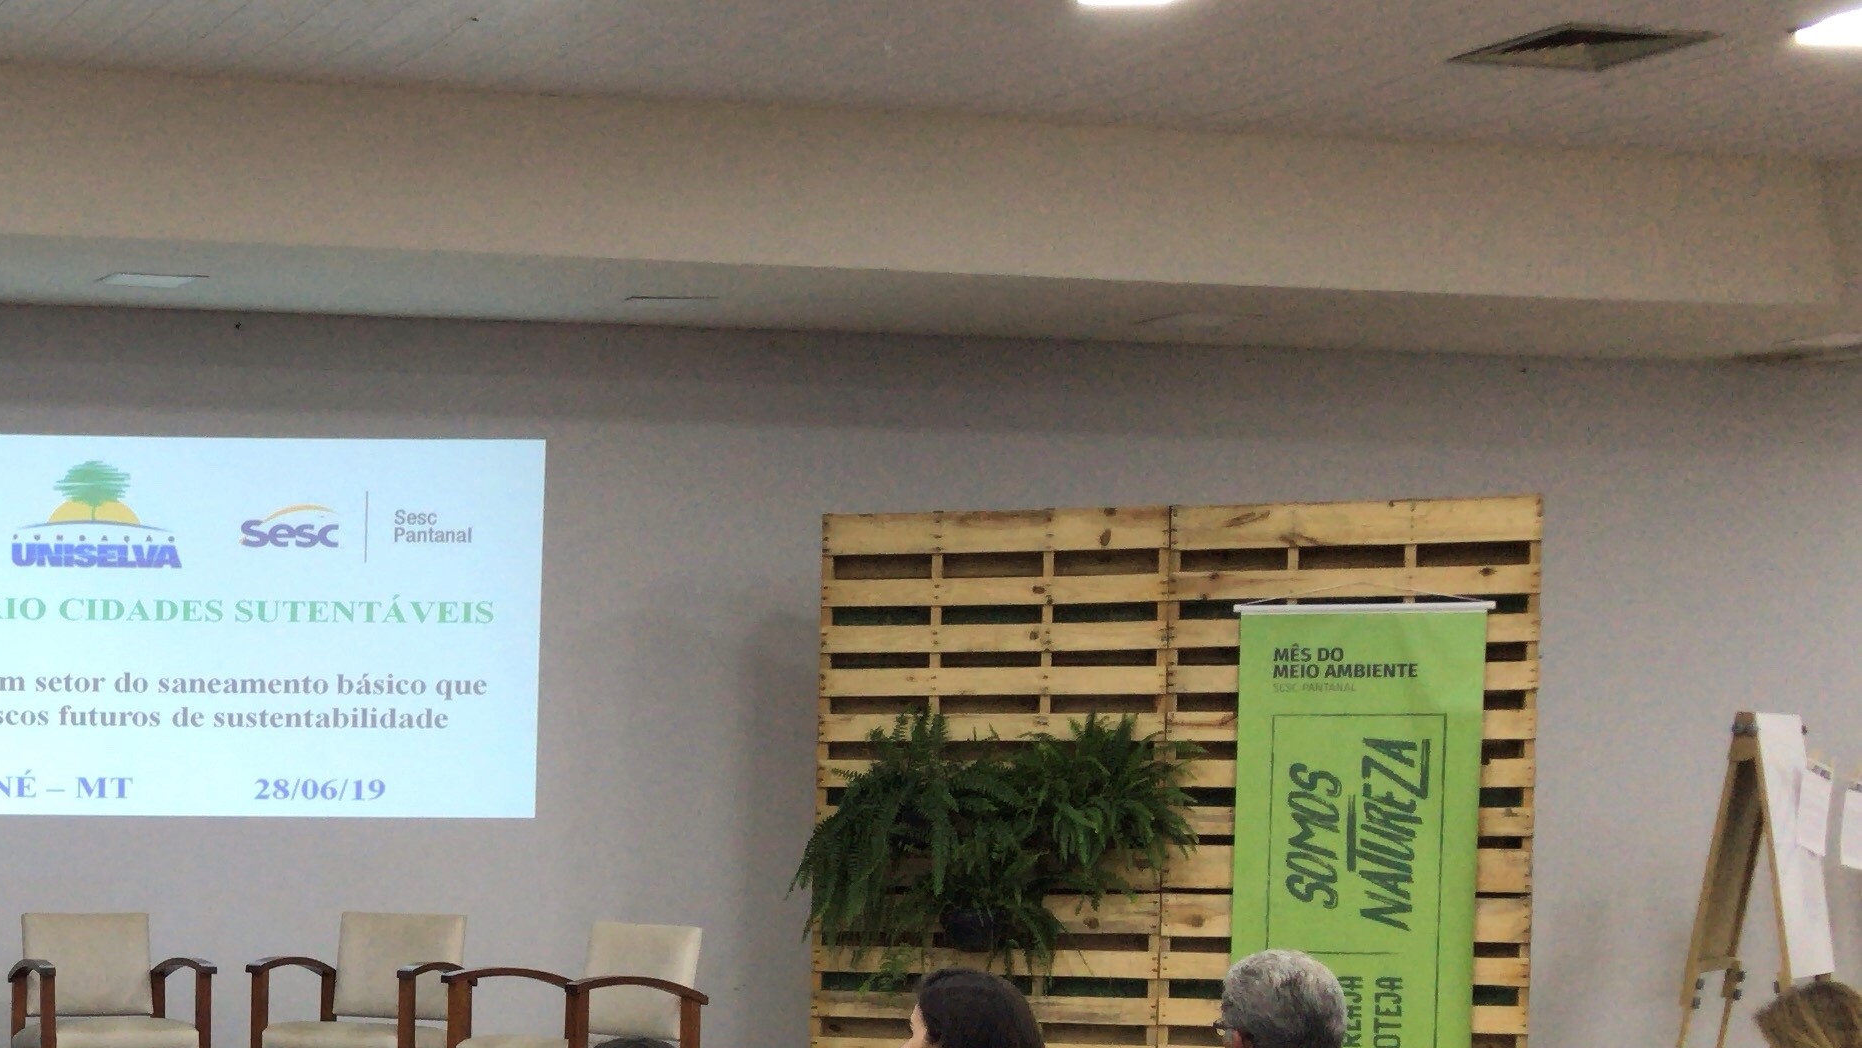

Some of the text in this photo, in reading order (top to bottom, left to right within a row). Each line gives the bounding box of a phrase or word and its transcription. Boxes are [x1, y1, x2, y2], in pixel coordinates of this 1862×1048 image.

[394, 509, 438, 526] Sesc
[394, 527, 473, 543] Pantanal
[11, 543, 183, 569] UNISELVA
[59, 597, 223, 622] CIDADES
[234, 594, 495, 624] SUTENTÁVEIS
[1273, 643, 1344, 662] MÊS DO
[1273, 663, 1418, 679] MEIO AMBIENTE
[35, 673, 106, 693] setor
[114, 672, 149, 693] do
[158, 676, 329, 694] saneamento
[337, 673, 426, 695] básico
[435, 678, 488, 700] que
[58, 705, 161, 728] futuros
[172, 707, 205, 728] de
[213, 708, 449, 729] sustentabilidade
[75, 776, 134, 799] MT
[254, 778, 386, 801] 28/06/19
[1286, 763, 1342, 910] SOMOS
[1347, 737, 1431, 931] NATUREZA
